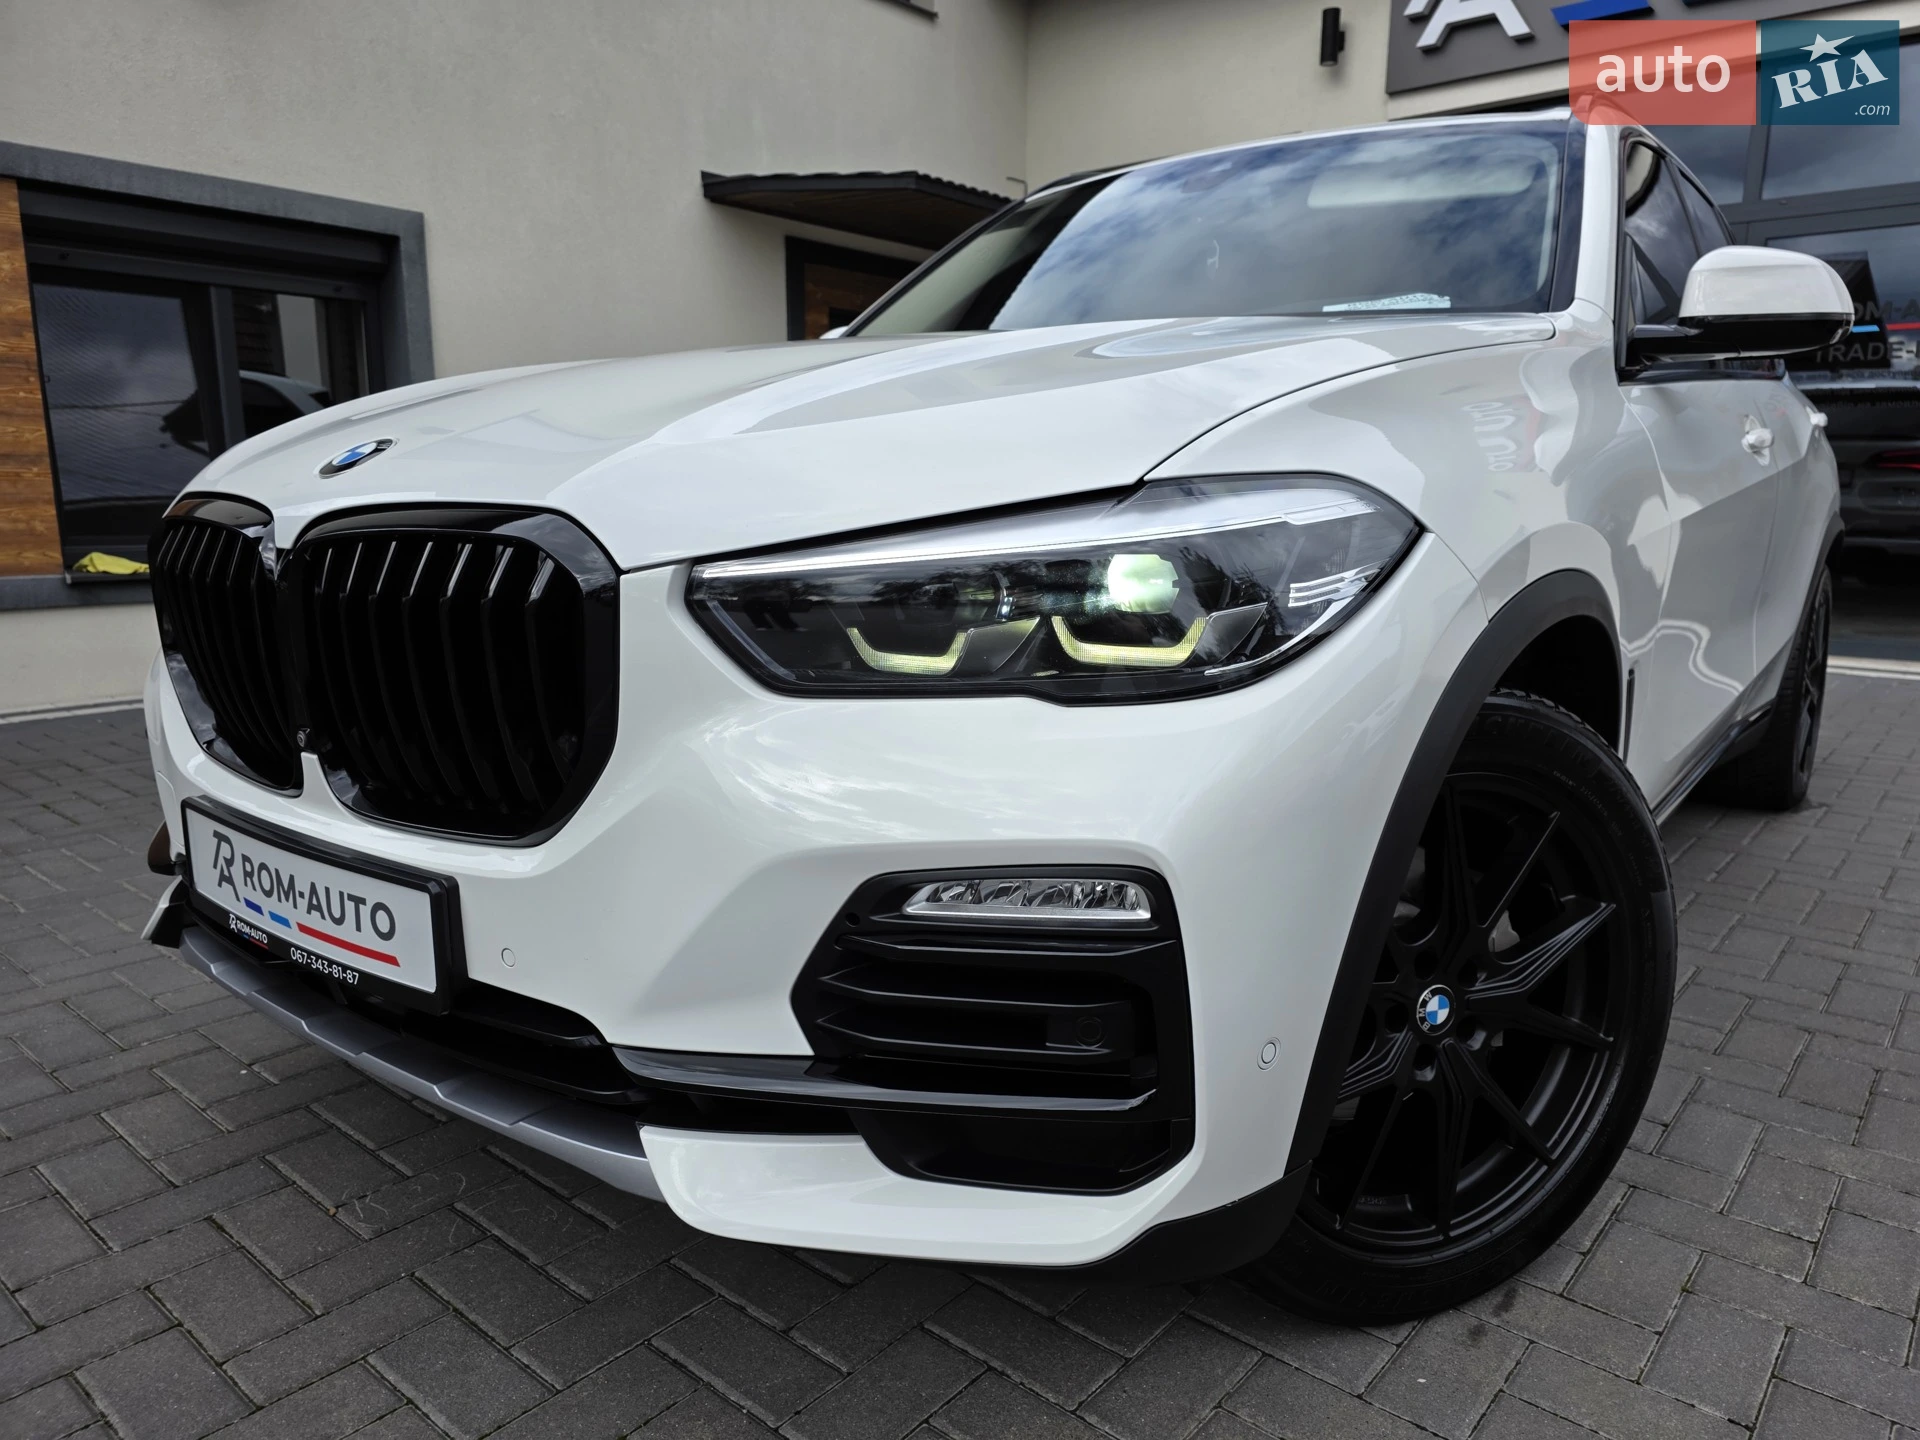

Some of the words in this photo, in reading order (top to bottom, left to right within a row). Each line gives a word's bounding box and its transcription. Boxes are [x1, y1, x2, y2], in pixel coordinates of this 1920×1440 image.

[241, 853, 396, 942] ROM-AUTO
[236, 920, 268, 944] ROM-AUTO
[290, 947, 359, 985] 067-343-81-87
